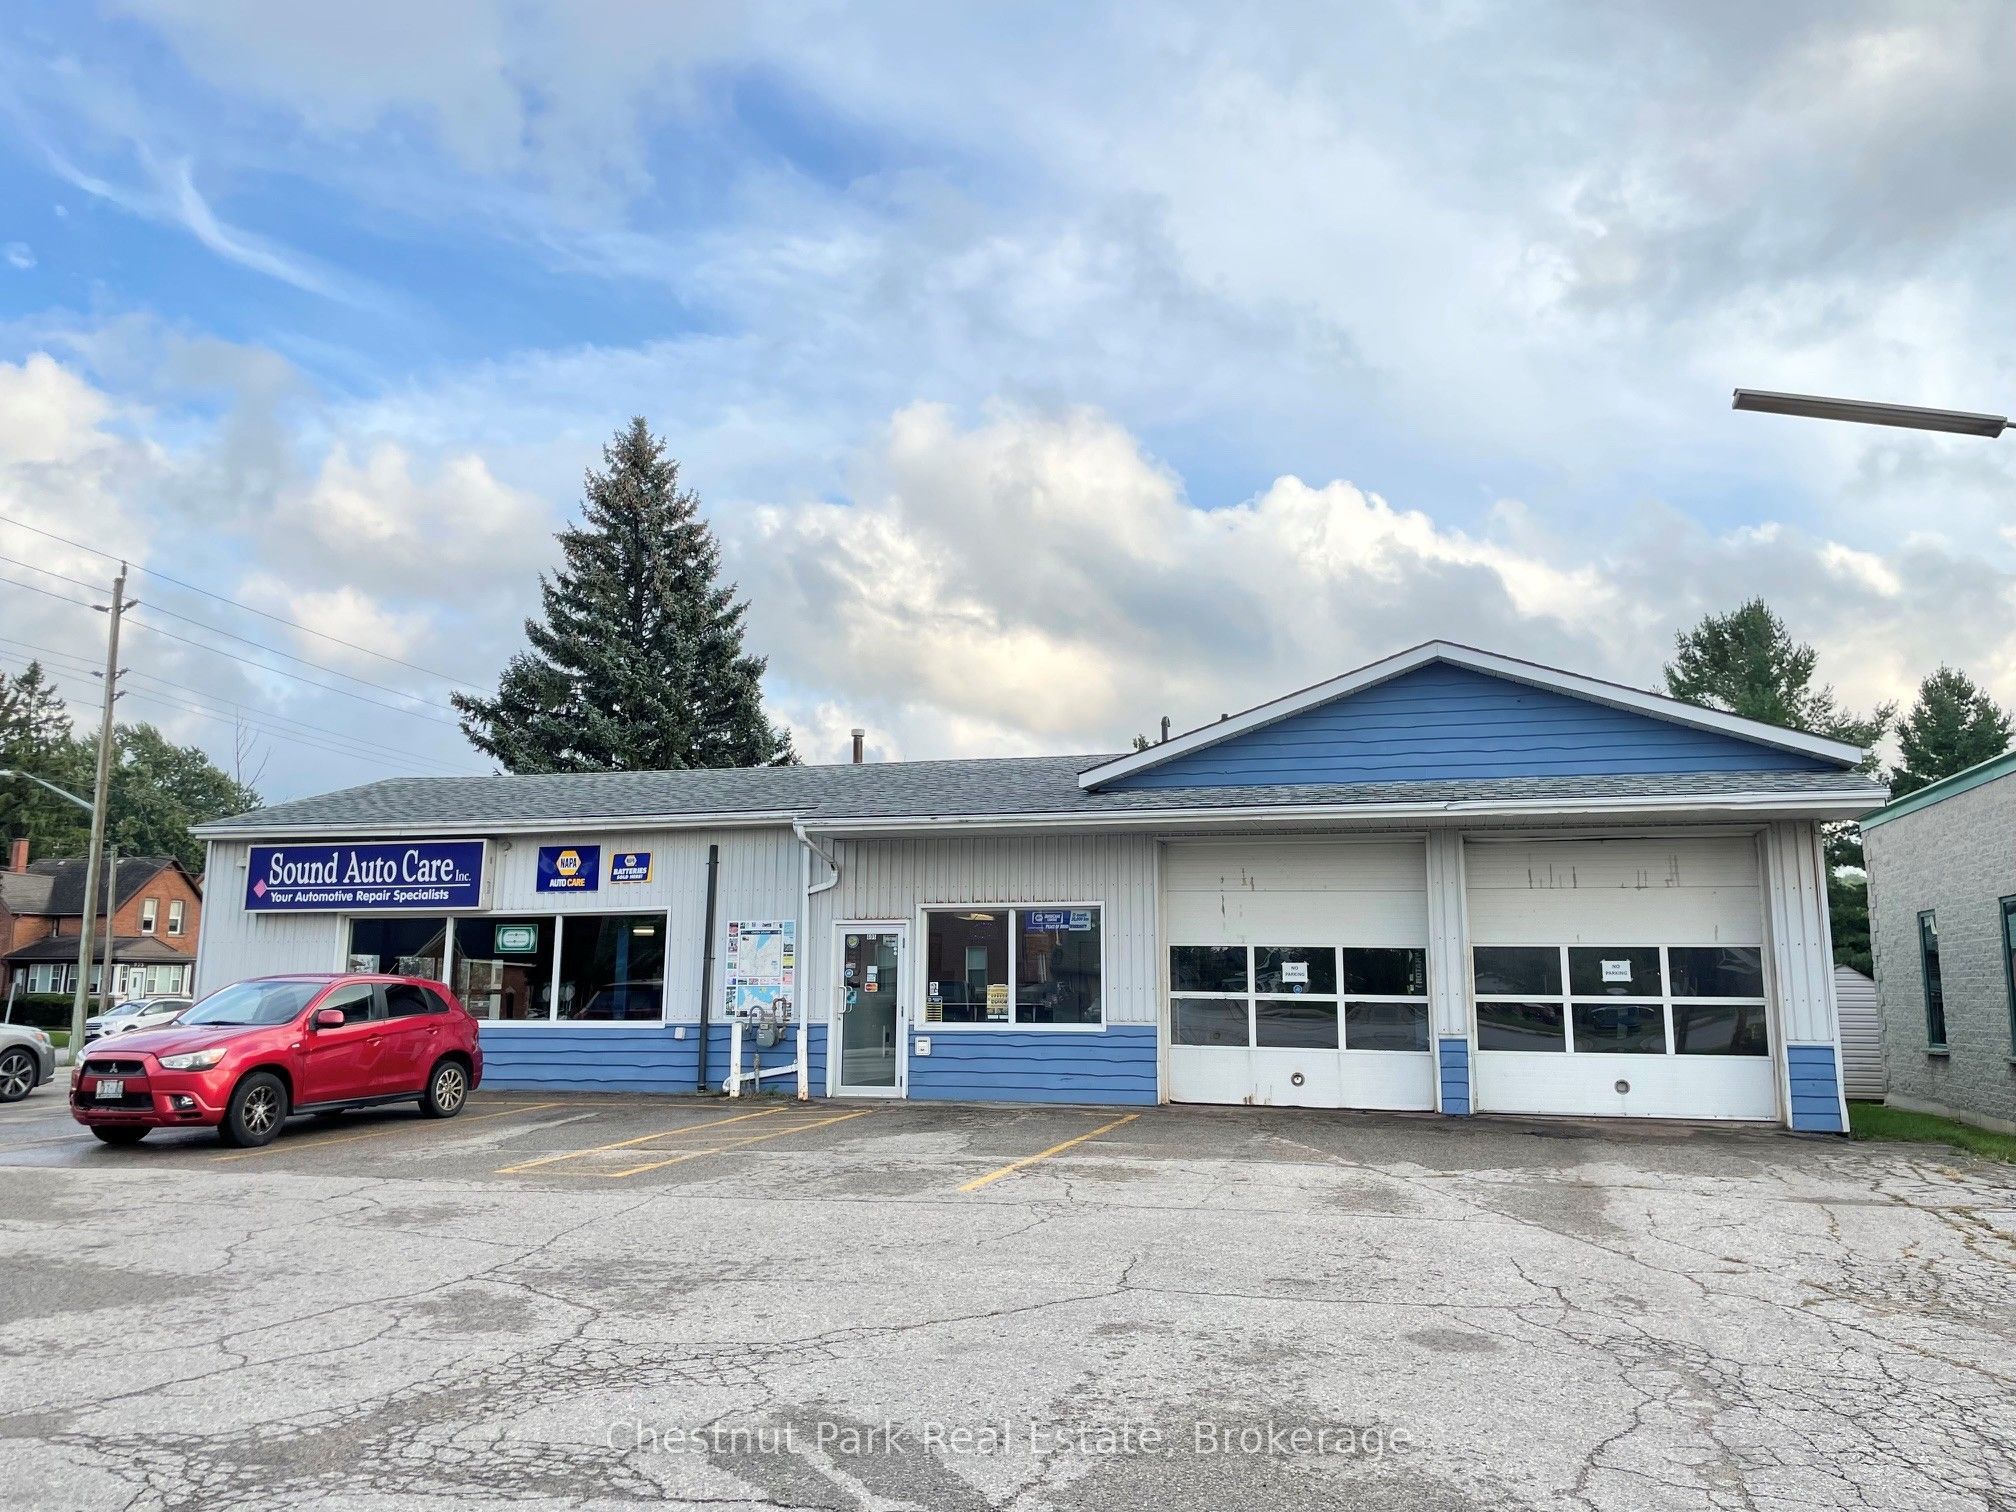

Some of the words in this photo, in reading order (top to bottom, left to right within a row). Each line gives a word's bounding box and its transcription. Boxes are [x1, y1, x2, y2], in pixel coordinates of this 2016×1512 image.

[269, 852, 339, 885] Sound
[343, 851, 397, 883] Auto
[402, 849, 454, 882] Care
[455, 869, 472, 882] Inc.
[560, 858, 577, 869] NAPA
[549, 879, 567, 887] AUTO
[567, 878, 585, 887] CARE
[270, 892, 293, 903] Your
[294, 891, 353, 902] Automotive
[356, 890, 390, 903] Repair
[392, 889, 449, 903] Specialists
